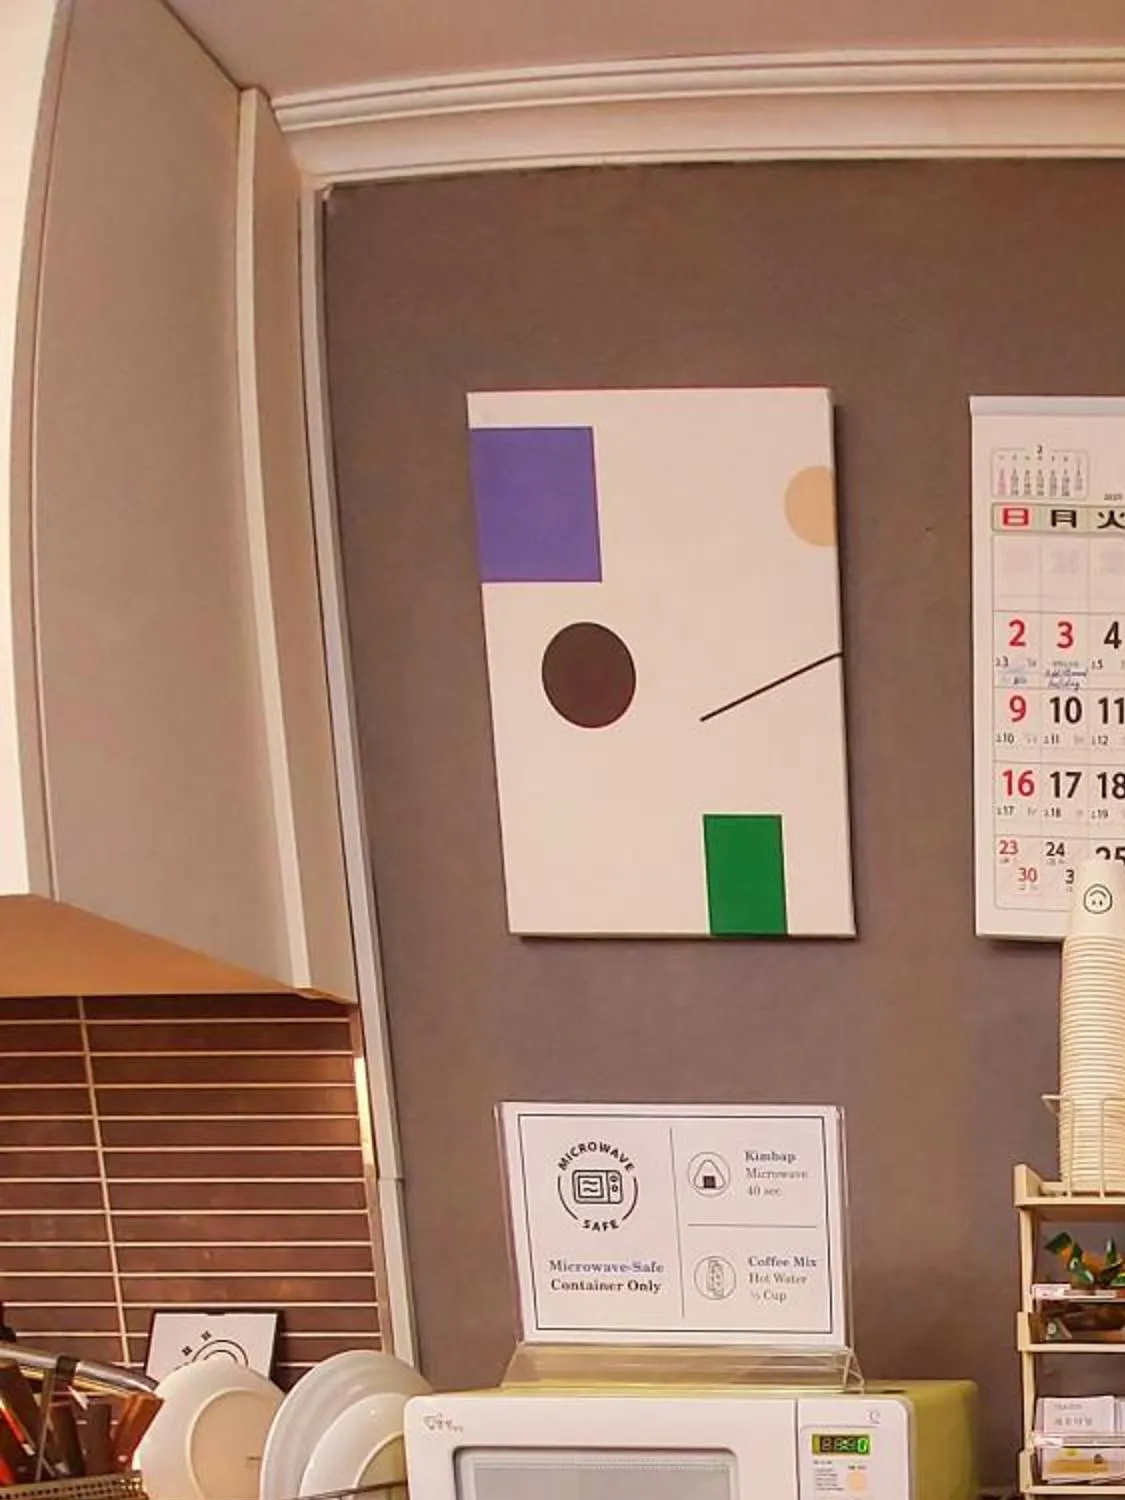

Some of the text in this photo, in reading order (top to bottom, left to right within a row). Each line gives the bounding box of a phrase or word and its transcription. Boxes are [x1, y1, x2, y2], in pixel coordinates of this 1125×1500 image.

[1003, 508, 1028, 527] 日
[1051, 509, 1077, 528] 月
[1097, 510, 1125, 529] 火
[1009, 619, 1026, 647] 2
[1057, 621, 1074, 649] 3
[1104, 621, 1122, 649] 4
[1009, 695, 1027, 722] 9
[1050, 696, 1082, 724] 10
[1098, 697, 1125, 724] 11
[1002, 769, 1035, 797] 16
[1050, 771, 1082, 798] 17
[1000, 839, 1018, 855] 23
[1045, 842, 1065, 857] 24
[1018, 867, 1075, 884] 30 3
[557, 1141, 635, 1172] MICROWAVE
[745, 1151, 797, 1164] Kimbap
[745, 1168, 808, 1179] Microwave
[583, 1219, 619, 1232] SAFE
[549, 1259, 665, 1273] Microwave-Safe
[748, 1256, 817, 1267] Coffee Mix
[748, 1272, 807, 1284] Hot Water
[550, 1279, 661, 1294] Container Only
[763, 1290, 787, 1302] Cup
